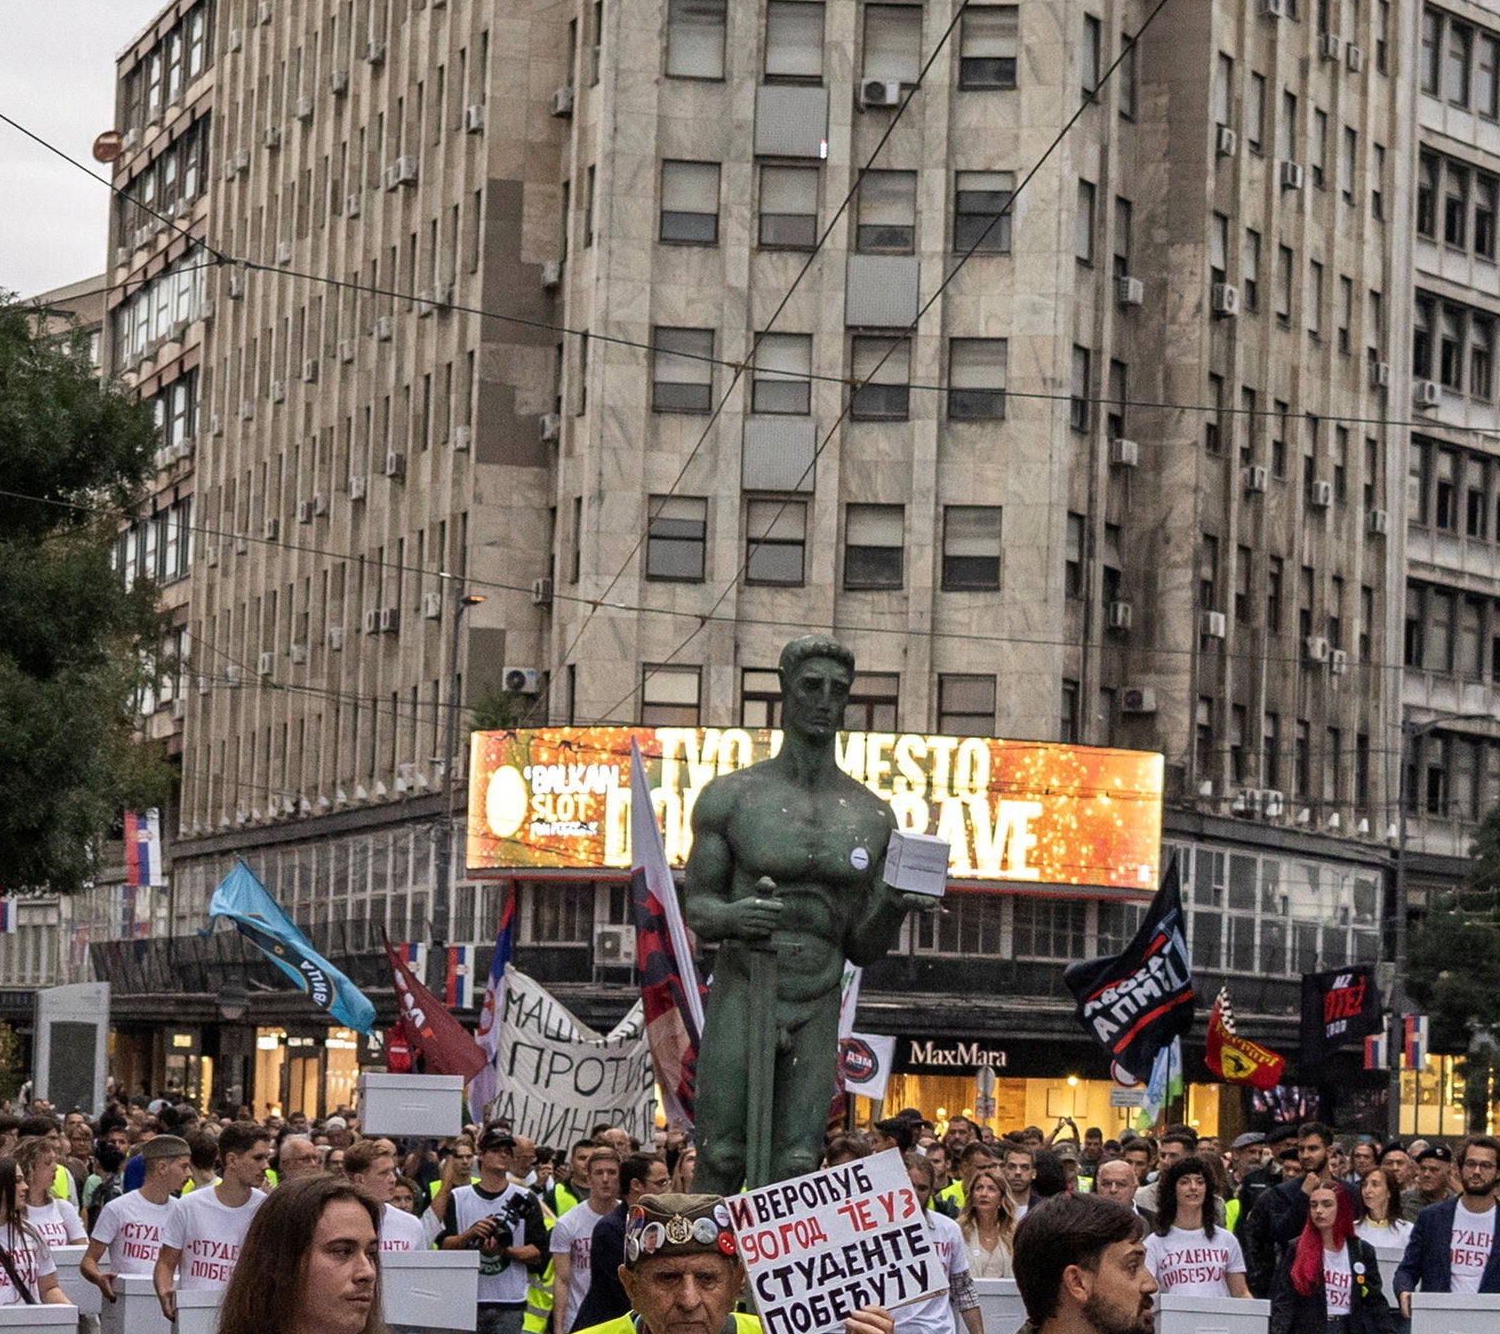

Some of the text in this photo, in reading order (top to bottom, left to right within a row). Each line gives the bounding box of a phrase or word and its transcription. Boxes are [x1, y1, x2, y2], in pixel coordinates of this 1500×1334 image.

[531, 794, 591, 822] SLOT
[890, 792, 1042, 880] BAVE
[908, 1040, 1007, 1067] MaxMara
[508, 1040, 656, 1097] ПРОТИВ
[729, 1198, 755, 1231] И
[124, 1222, 160, 1242] СТУД
[122, 1241, 158, 1262] ПОБЕ
[193, 1239, 240, 1261] СТУДЕ
[755, 1223, 931, 1303] СТУДЕНТЕ
[190, 1260, 228, 1282] ПОБЕ
